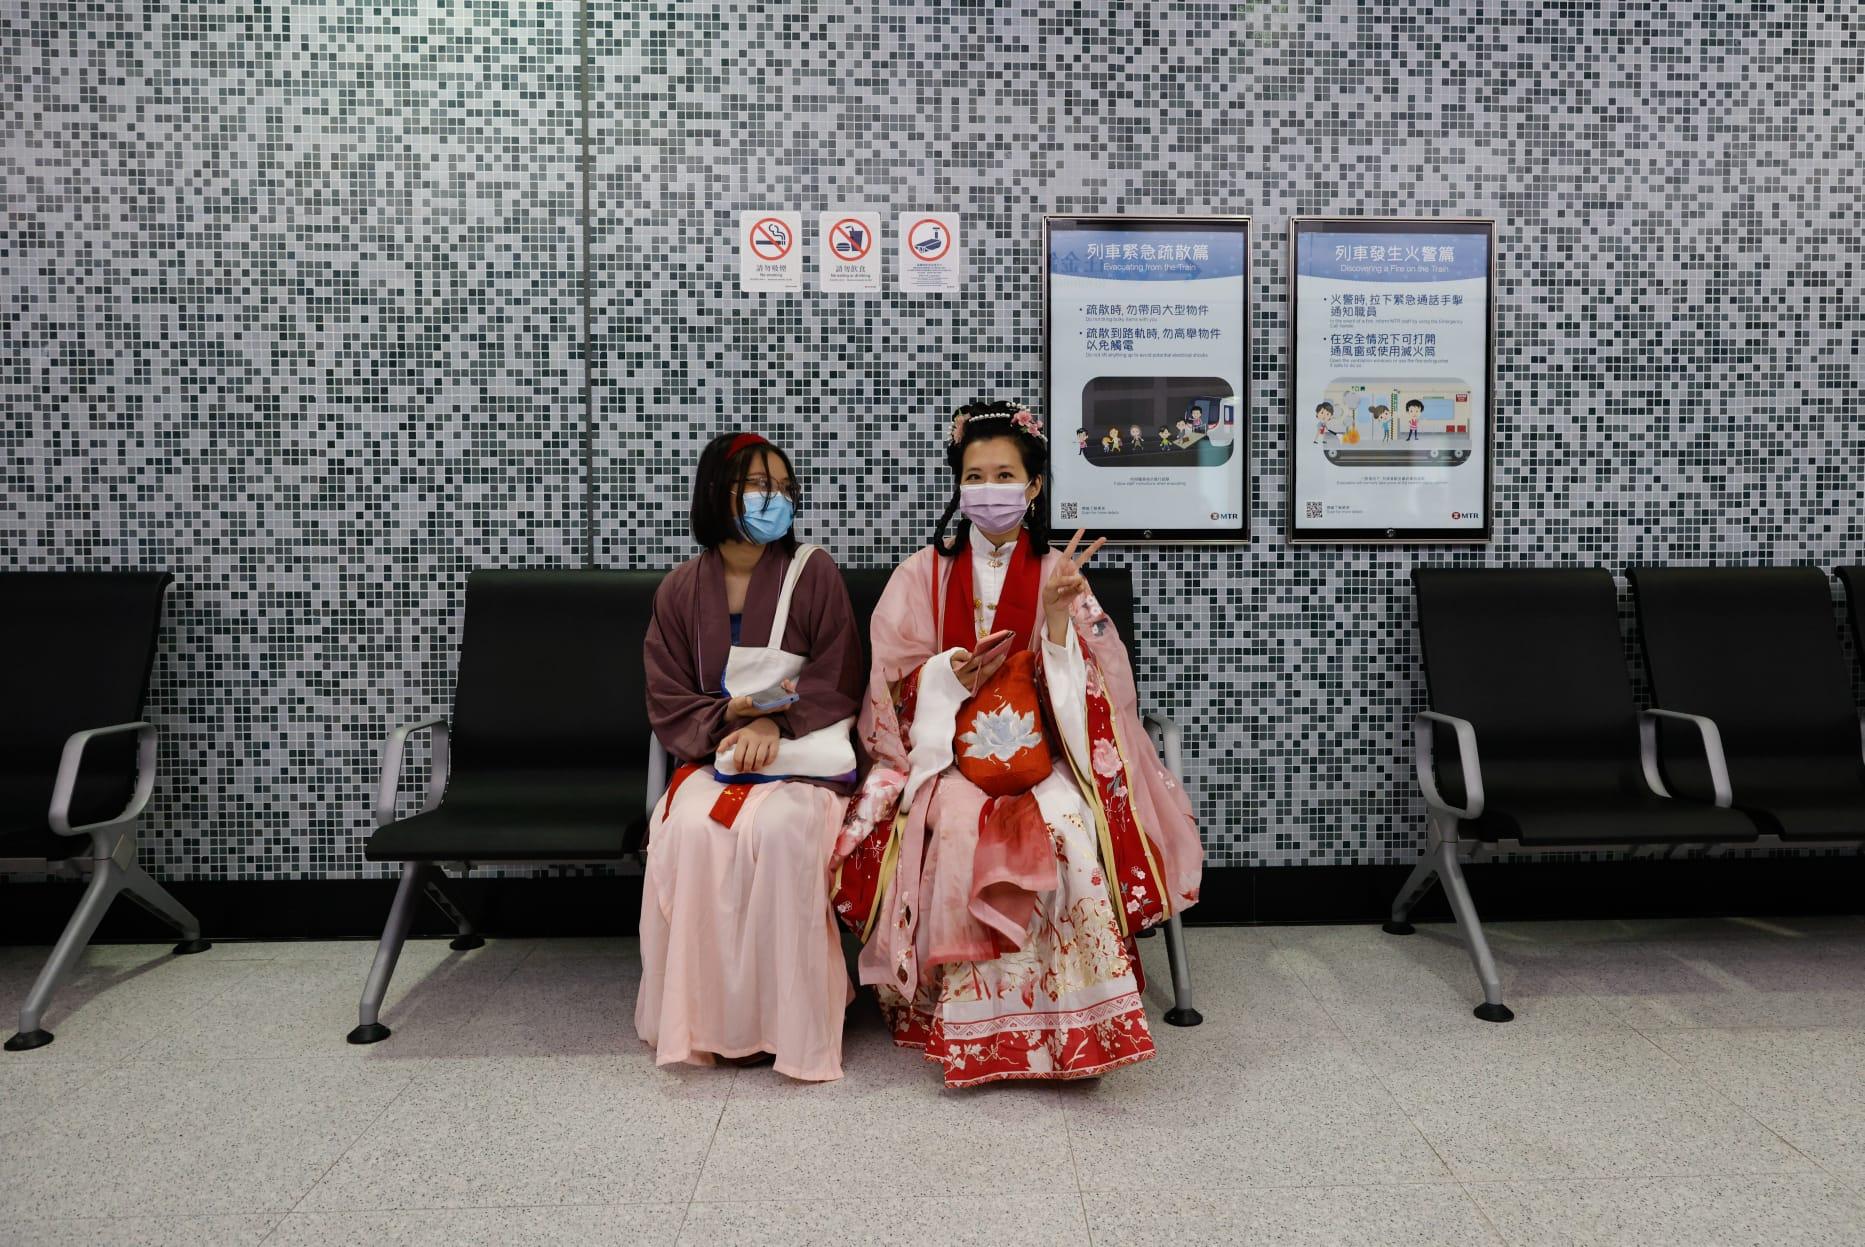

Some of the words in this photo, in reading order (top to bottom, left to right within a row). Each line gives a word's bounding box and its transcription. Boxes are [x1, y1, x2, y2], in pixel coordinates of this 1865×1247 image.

[1087, 242, 1209, 261] 列車緊急疏散篇
[1335, 245, 1454, 262] 列車發生火警篇
[1104, 263, 1144, 272] Evacuating
[1340, 265, 1382, 273] Discovering
[1331, 306, 1377, 317] 通知職員
[1331, 333, 1436, 345] 在安全情況下可打開
[1086, 340, 1134, 351] 以免觸電
